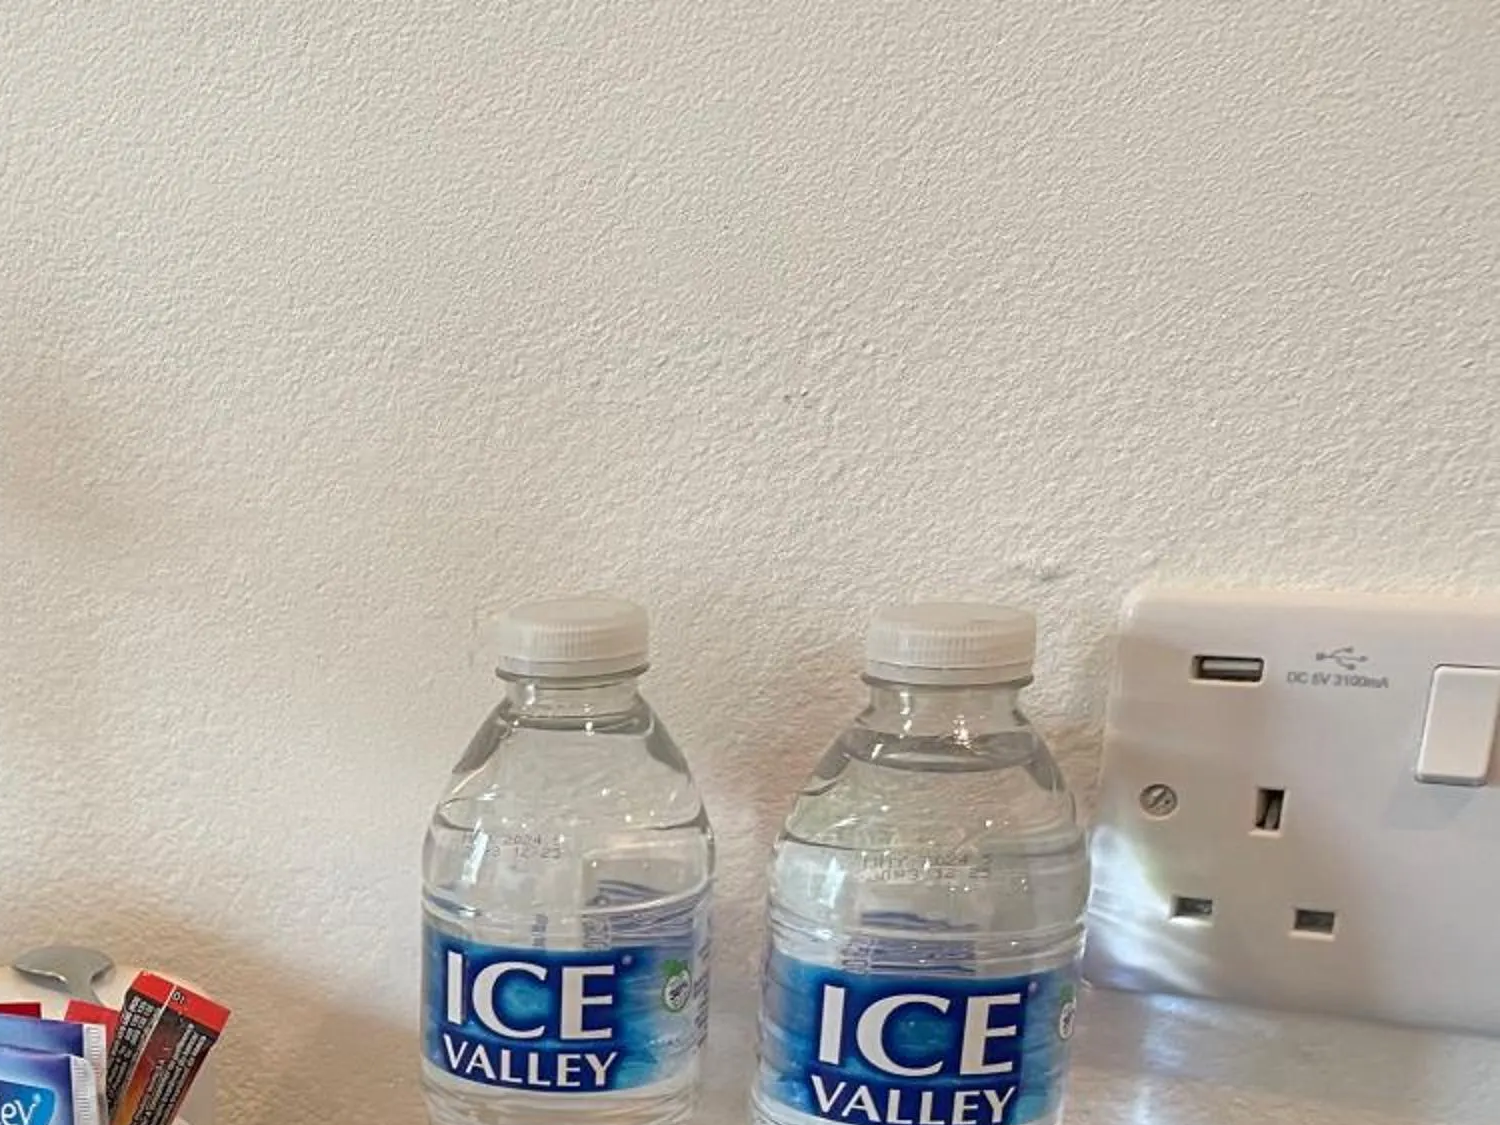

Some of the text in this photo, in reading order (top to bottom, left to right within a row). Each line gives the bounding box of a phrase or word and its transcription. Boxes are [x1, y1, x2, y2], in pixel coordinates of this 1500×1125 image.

[447, 950, 615, 1040] ICE
[819, 983, 1022, 1077] ICE
[443, 1032, 618, 1088] VALLEY
